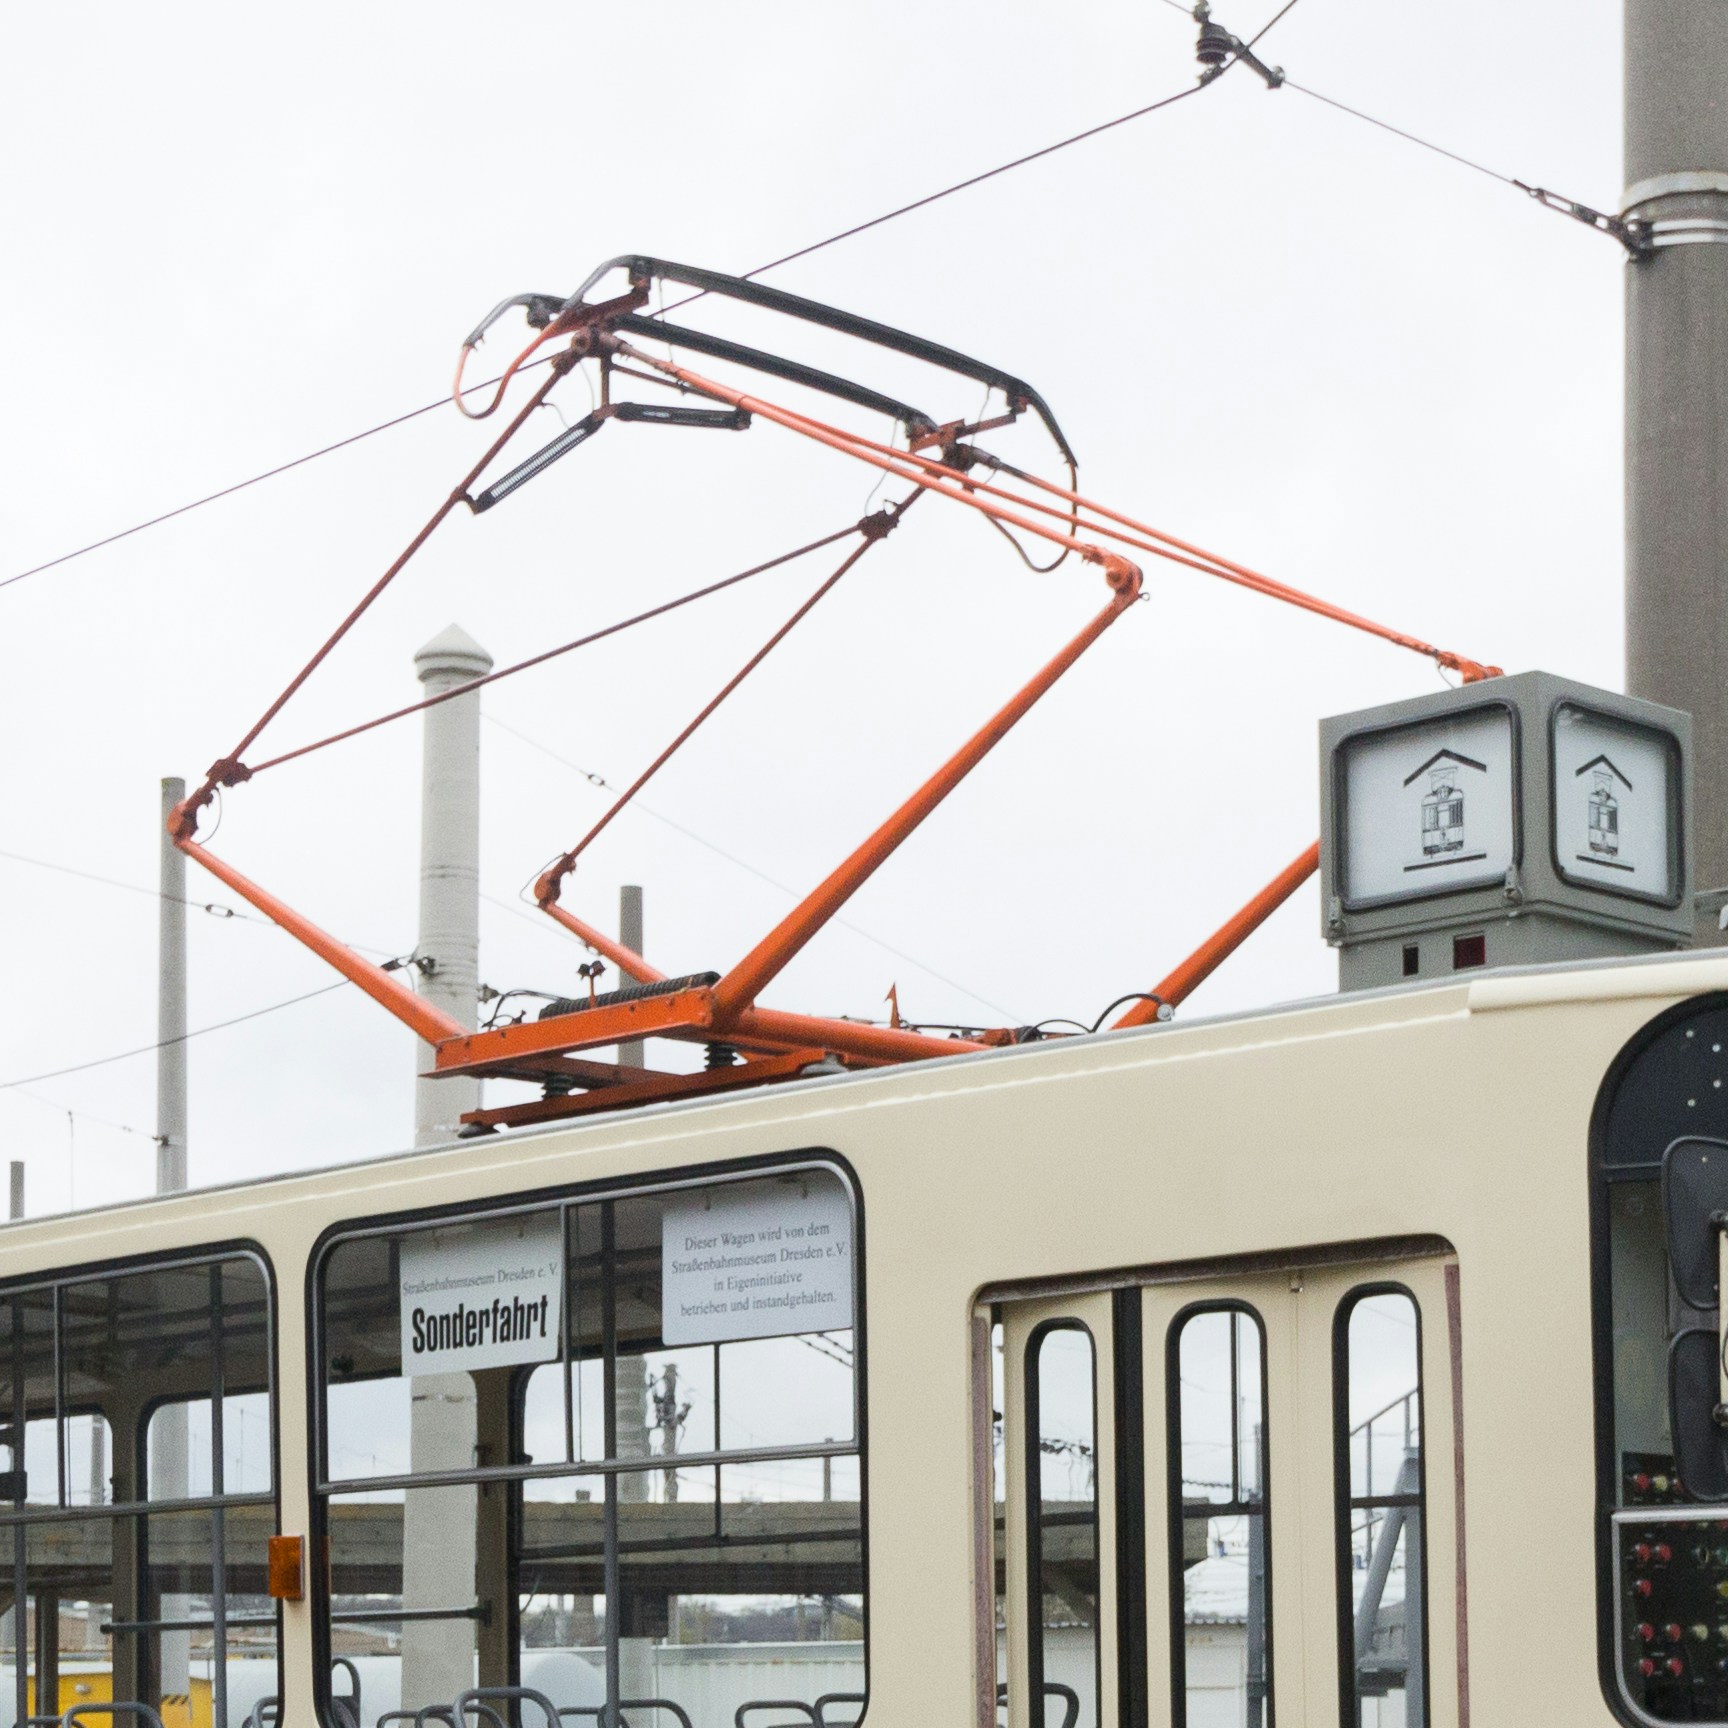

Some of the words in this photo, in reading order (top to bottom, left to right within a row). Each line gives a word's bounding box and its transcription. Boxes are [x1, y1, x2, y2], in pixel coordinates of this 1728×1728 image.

[684, 1236, 718, 1251] Dieser
[721, 1232, 755, 1248] Wagen
[758, 1227, 782, 1241] wird
[784, 1226, 805, 1238] von
[807, 1222, 830, 1236] dem
[671, 1253, 778, 1274] Straßenbahnmuseum
[780, 1245, 823, 1262] Dresden
[497, 1267, 537, 1283] Dresden
[714, 1280, 724, 1291] in
[727, 1271, 803, 1292] Eigeninitiative
[681, 1301, 727, 1316] betrieben
[731, 1298, 749, 1312] und
[412, 1295, 548, 1353] Sonderfahrt
